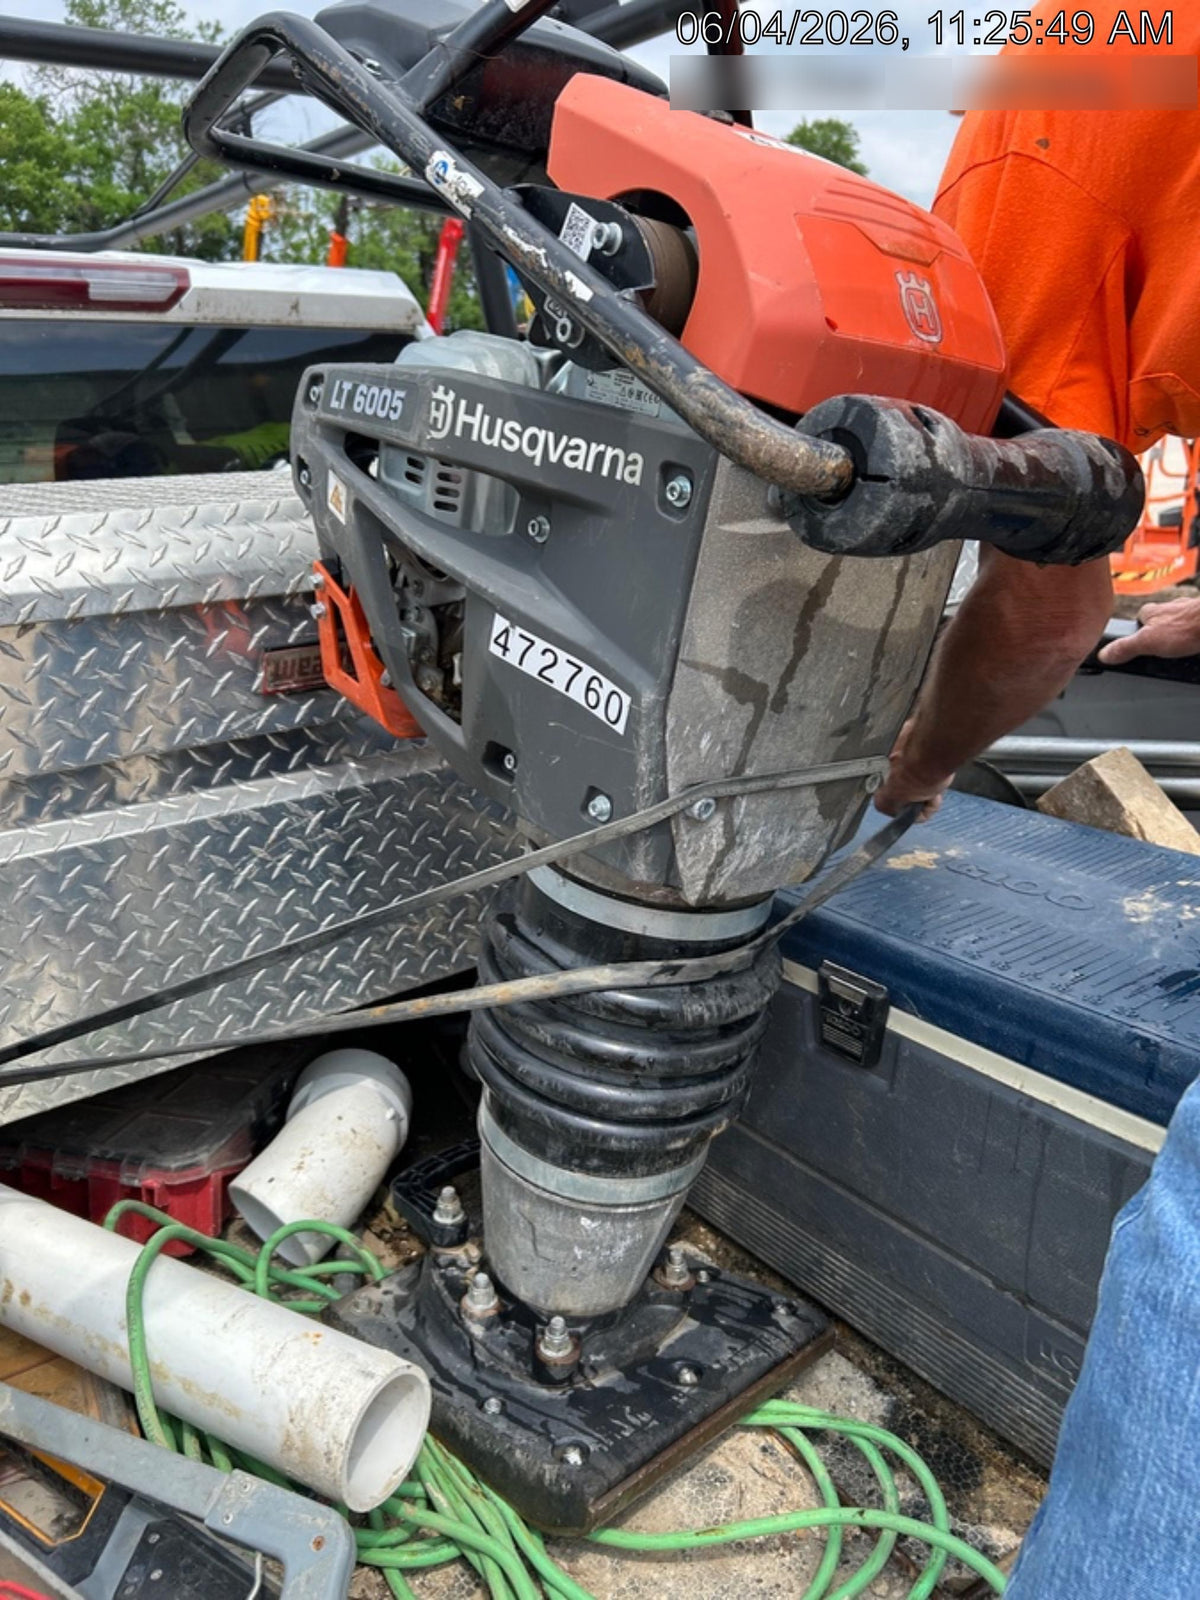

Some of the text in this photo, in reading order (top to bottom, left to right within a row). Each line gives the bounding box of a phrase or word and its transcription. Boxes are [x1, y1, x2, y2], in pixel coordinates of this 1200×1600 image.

[329, 380, 405, 420] LT 6005
[454, 398, 645, 486] Husqvarna
[493, 626, 625, 727] 472760
